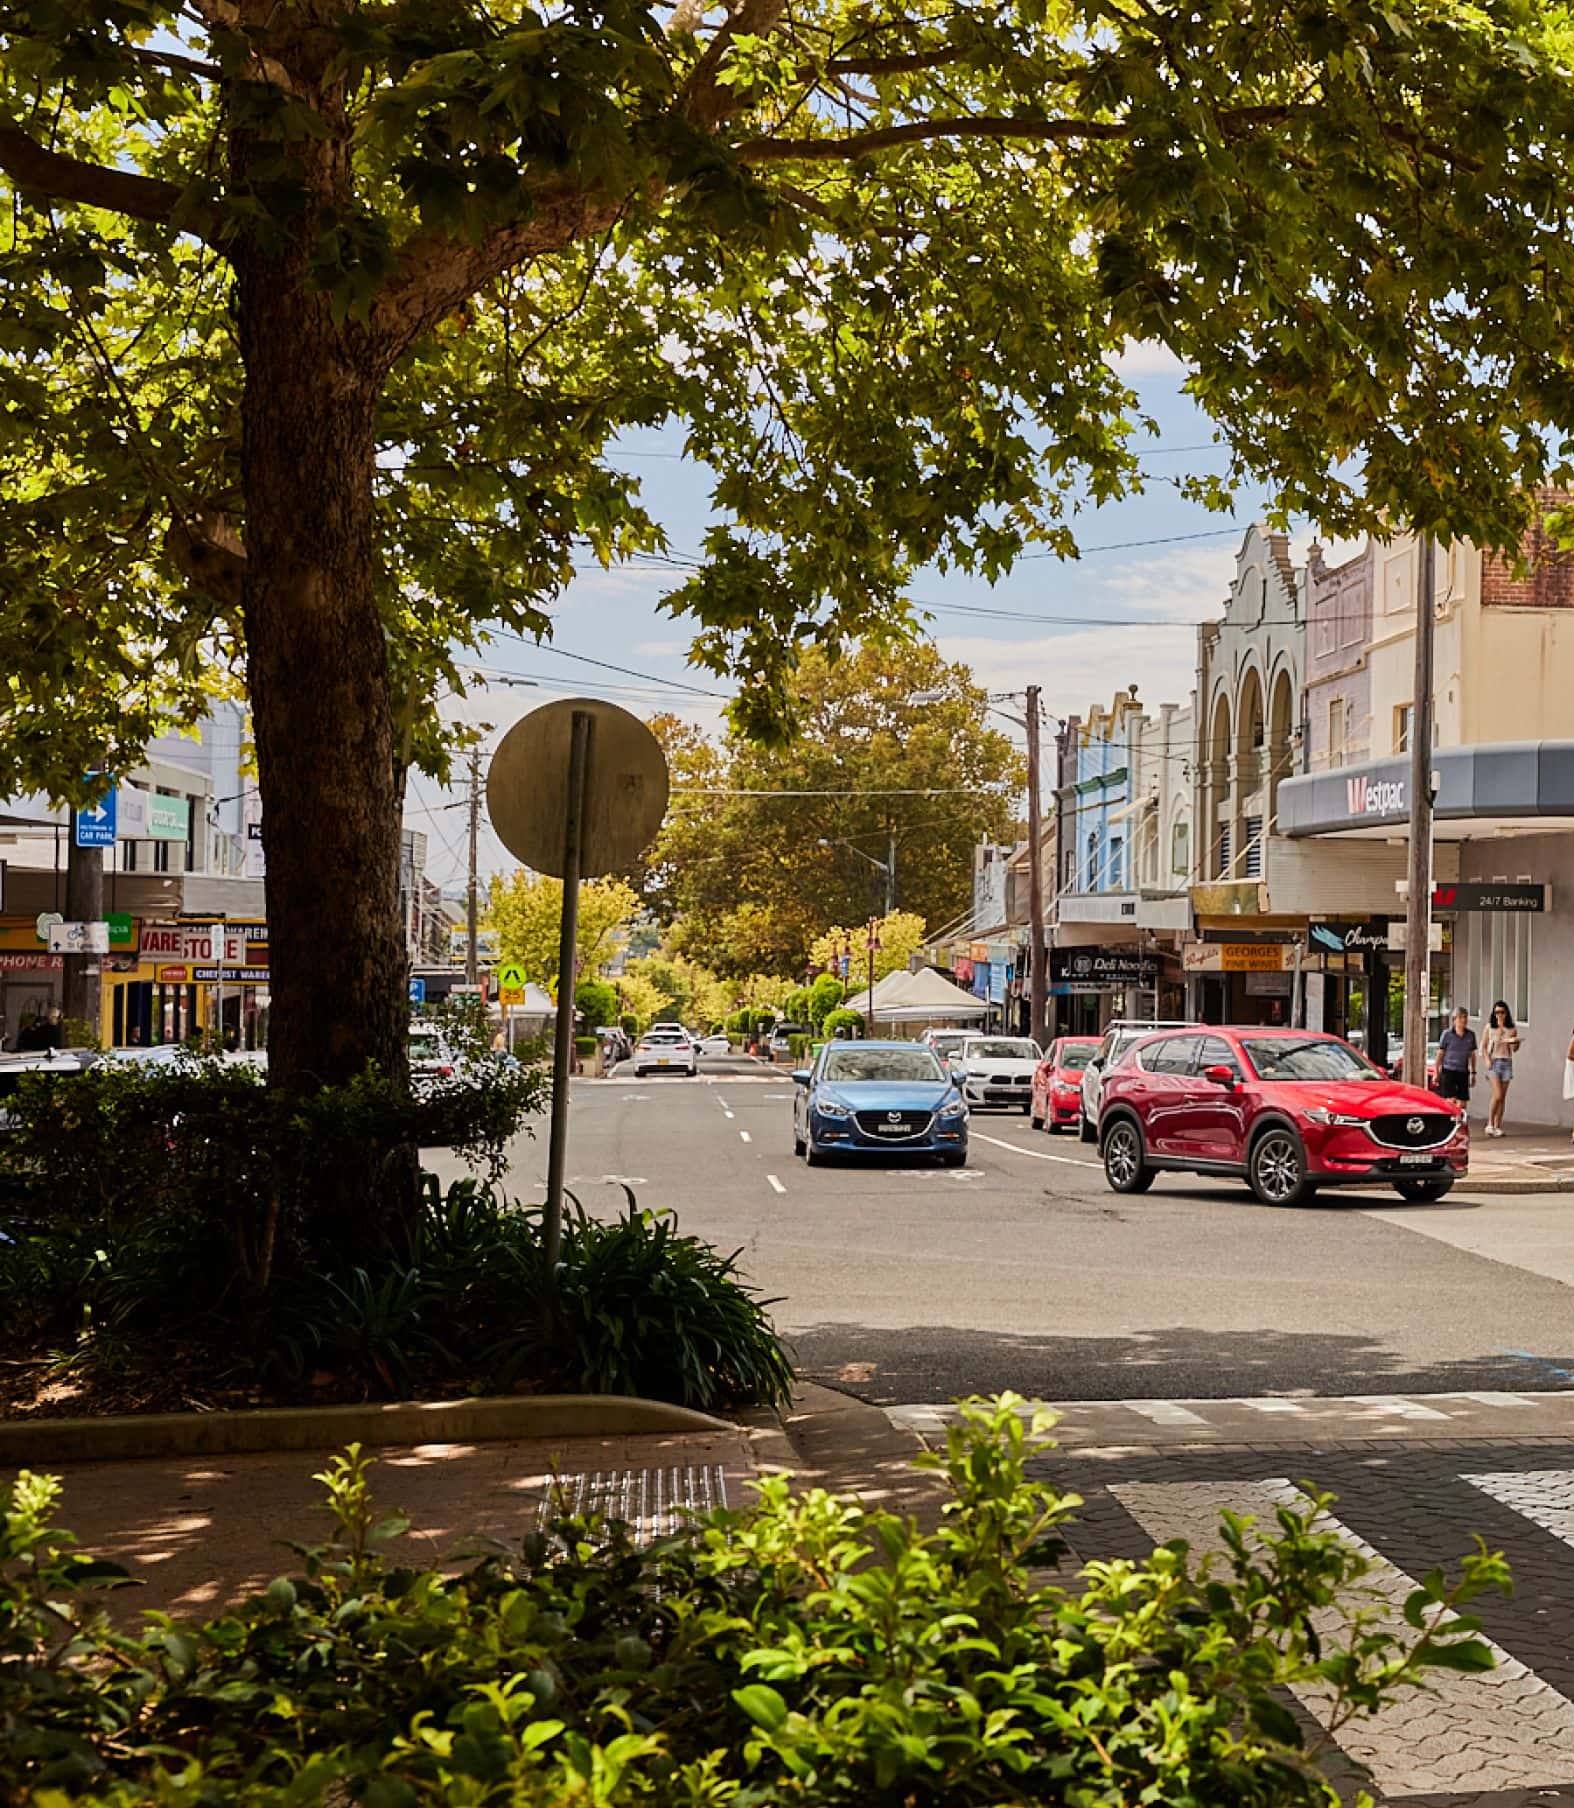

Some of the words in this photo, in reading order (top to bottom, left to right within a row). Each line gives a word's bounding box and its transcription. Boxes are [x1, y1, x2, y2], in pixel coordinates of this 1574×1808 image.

[1347, 776, 1404, 816] Westpac
[1479, 896, 1501, 906] 24/7
[1502, 896, 1537, 908] Banking
[1225, 945, 1279, 957] GEORGES
[1093, 957, 1116, 971] Deli
[1226, 959, 1245, 969] FINE
[1248, 959, 1279, 969] WINES
